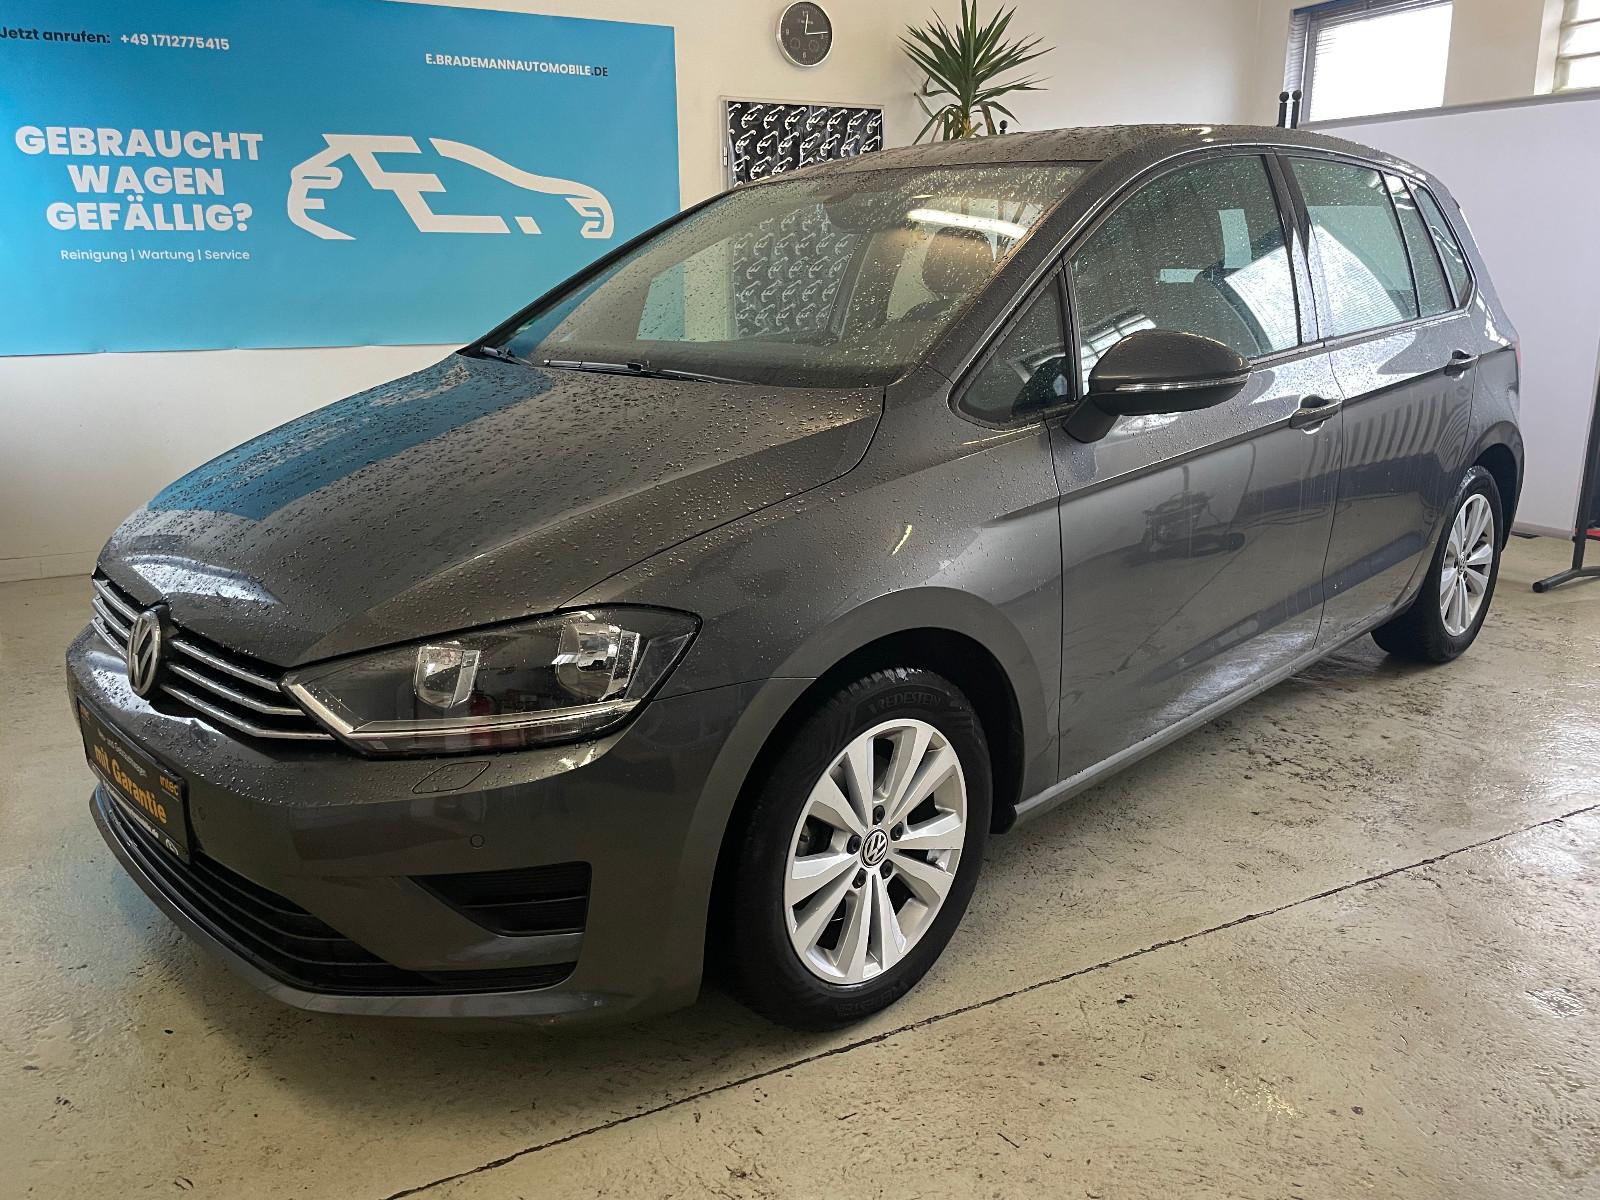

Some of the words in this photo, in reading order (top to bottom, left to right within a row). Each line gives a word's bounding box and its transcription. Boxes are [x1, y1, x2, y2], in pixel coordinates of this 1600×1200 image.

[0, 26, 39, 40] Jetzt
[42, 31, 111, 44] anrufen:
[120, 33, 148, 46] +49
[151, 34, 230, 50] 1712775415
[425, 53, 608, 77] E.BRADEMANNAUTOMOBILE.DE
[15, 125, 263, 160] GEBRAUCHT
[67, 164, 225, 195] WAGEN
[46, 194, 253, 231] GEFÄLLIG?
[60, 249, 128, 263] Reinigung
[138, 249, 194, 262] Wartung
[204, 249, 250, 260] Service
[111, 758, 167, 824] Garantie
